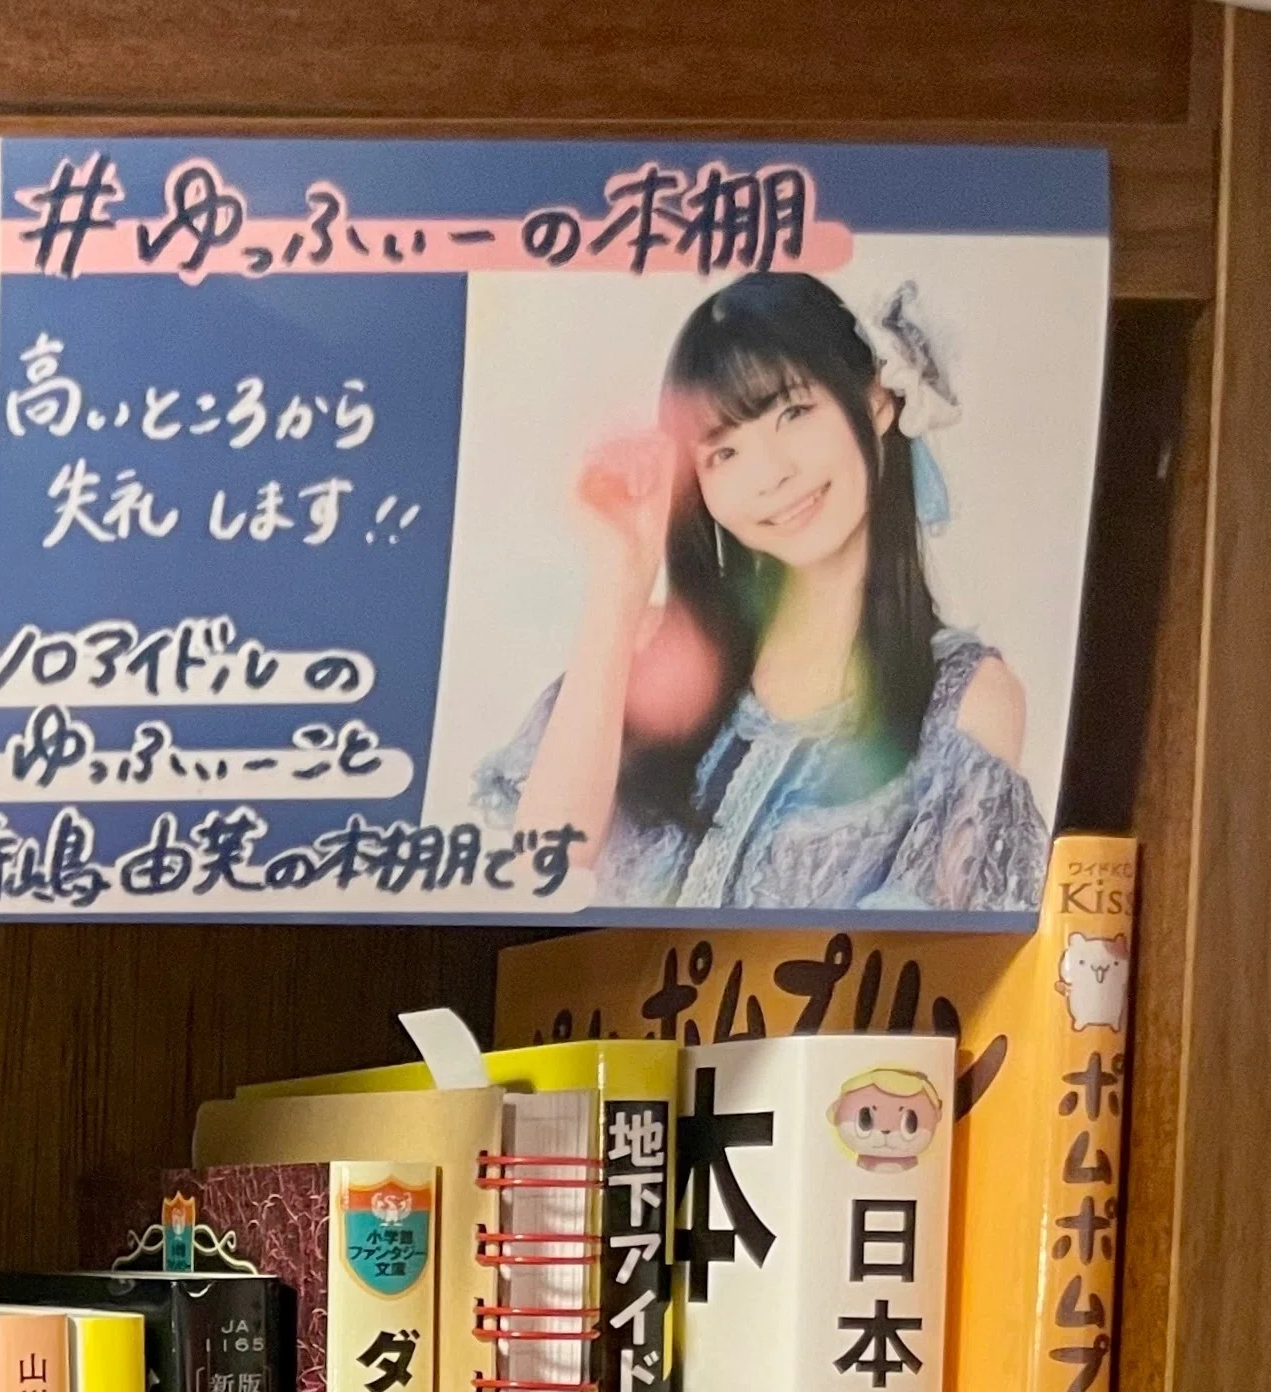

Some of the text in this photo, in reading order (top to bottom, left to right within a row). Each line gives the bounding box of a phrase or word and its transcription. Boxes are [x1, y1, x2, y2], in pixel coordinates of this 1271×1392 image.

[5, 332, 376, 449] 高いところから
[220, 1319, 250, 1334] JA
